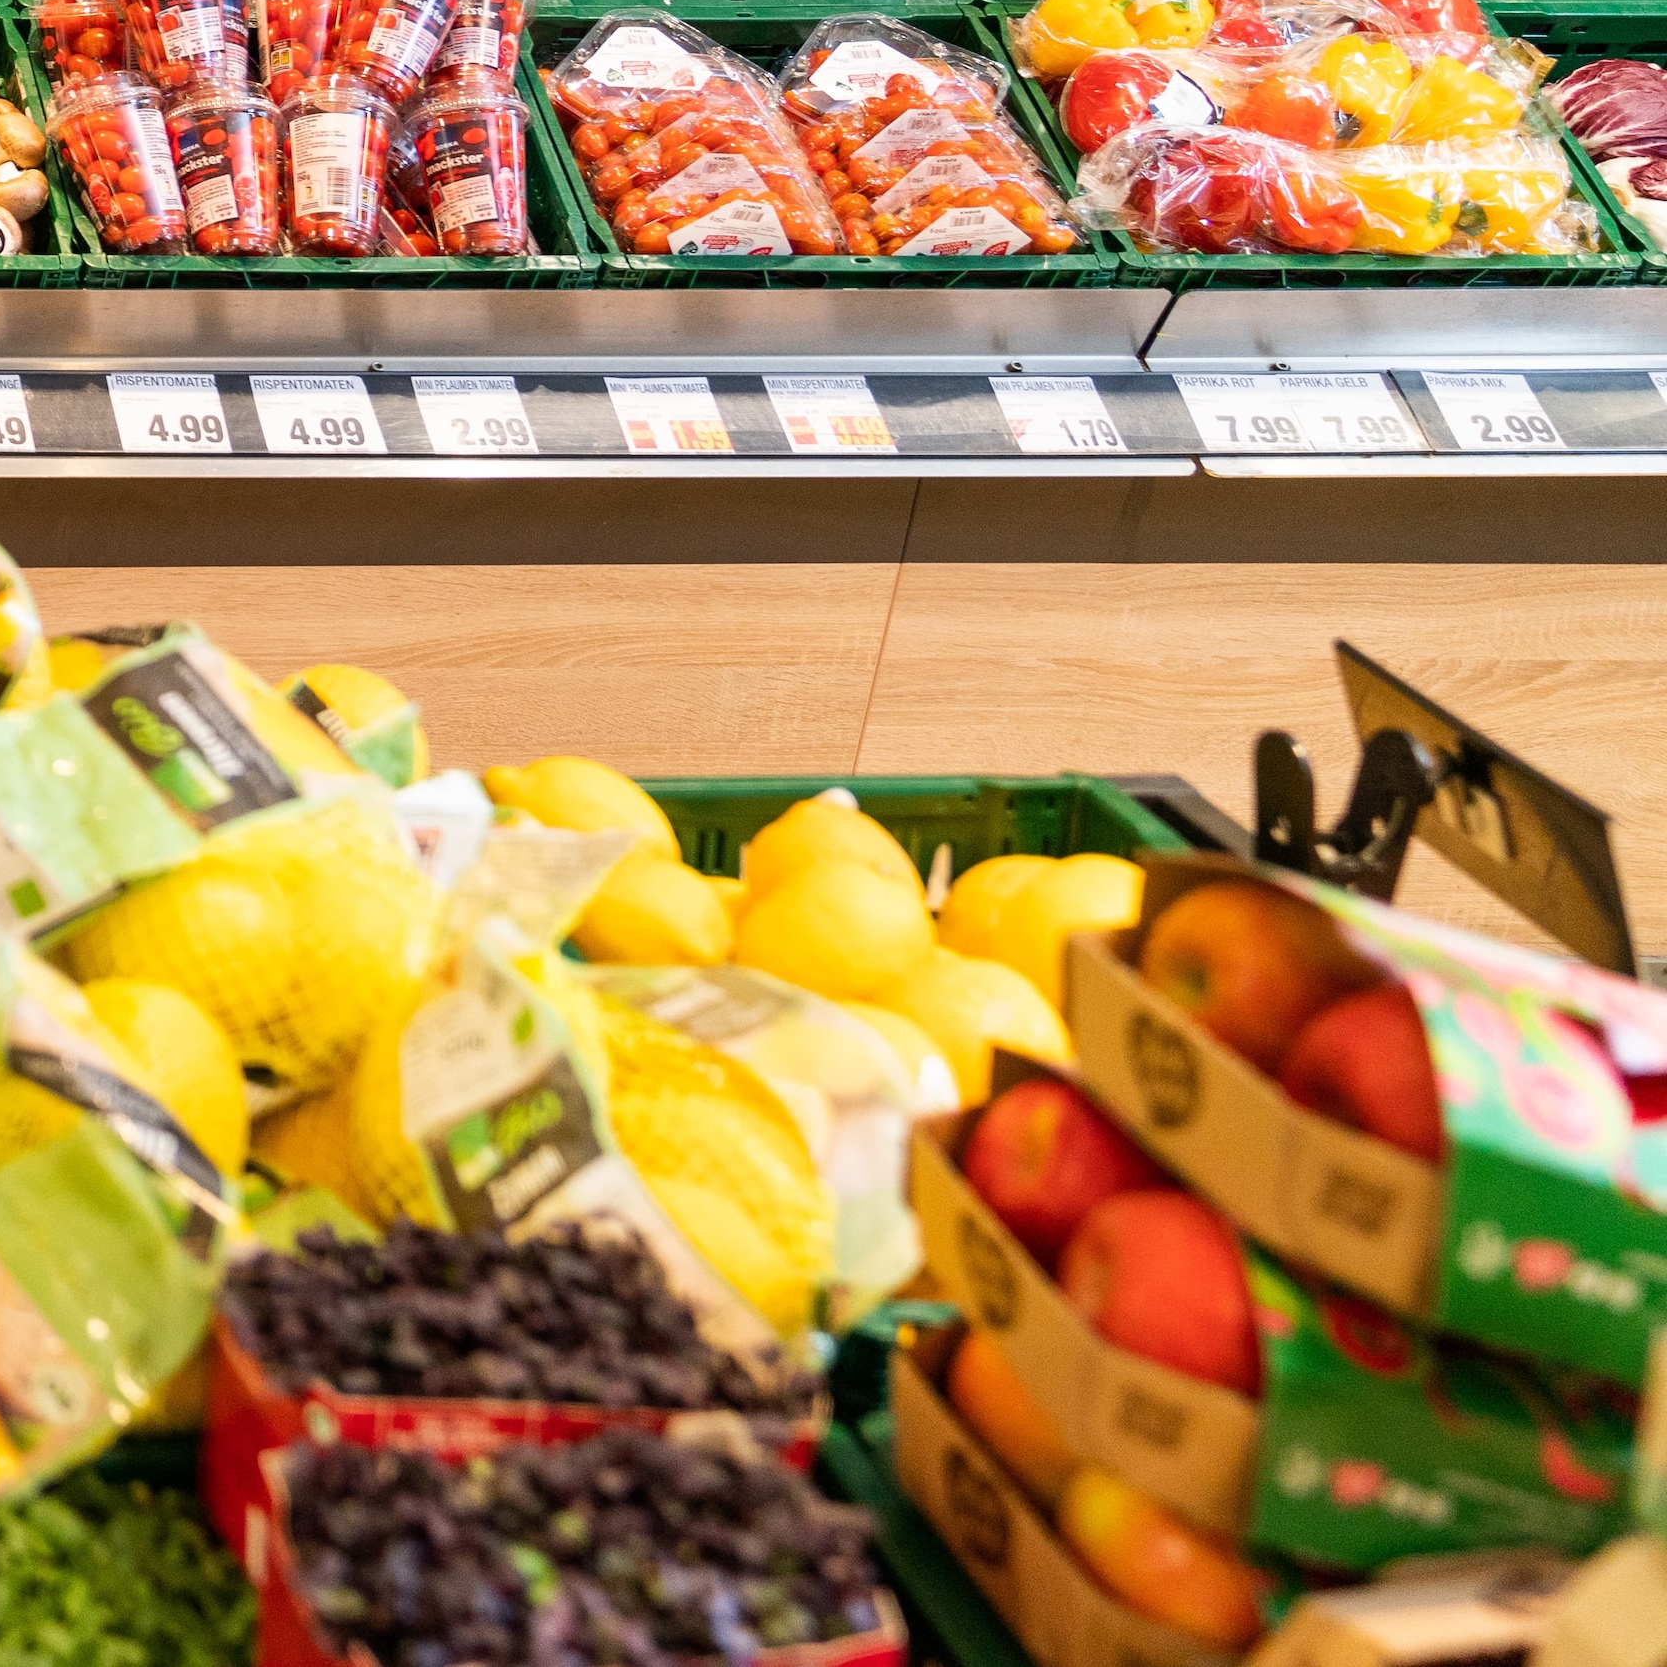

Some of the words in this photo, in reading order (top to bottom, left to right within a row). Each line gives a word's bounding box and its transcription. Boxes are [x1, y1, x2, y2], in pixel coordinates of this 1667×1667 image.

[116, 376, 217, 388] RISPENTOMATEN
[254, 380, 355, 390] RISPENTOMATEN
[417, 380, 433, 390] MINI
[435, 380, 478, 390] PFLAUMEN
[480, 380, 516, 390] TOMATEN
[609, 383, 627, 393] MINI
[629, 383, 672, 394] PFLAUMEN
[673, 383, 711, 394] TOMATEN
[767, 380, 789, 390] MINI
[791, 380, 867, 390] RISPENTOMATEN
[992, 381, 1010, 390] MINI
[1013, 382, 1054, 391] PFLAUMEN
[1057, 382, 1095, 392] TOMATEN
[1176, 376, 1228, 388] PAPRIKA
[1232, 378, 1255, 388] ROT
[1280, 377, 1331, 387] PAPRIKA
[1336, 378, 1368, 388] GELB
[1426, 375, 1479, 387] PAPRIKA
[1482, 377, 1505, 388] MIX
[149, 414, 224, 443] 4.99
[291, 418, 365, 446] 4.99
[451, 418, 530, 446] 2.99
[671, 420, 731, 449] 1.99
[831, 416, 893, 445] 3.99
[1059, 419, 1118, 447] 1.79
[1215, 415, 1300, 443] 7.99
[1322, 416, 1408, 443] 7.99
[1471, 415, 1556, 444] 2.99
